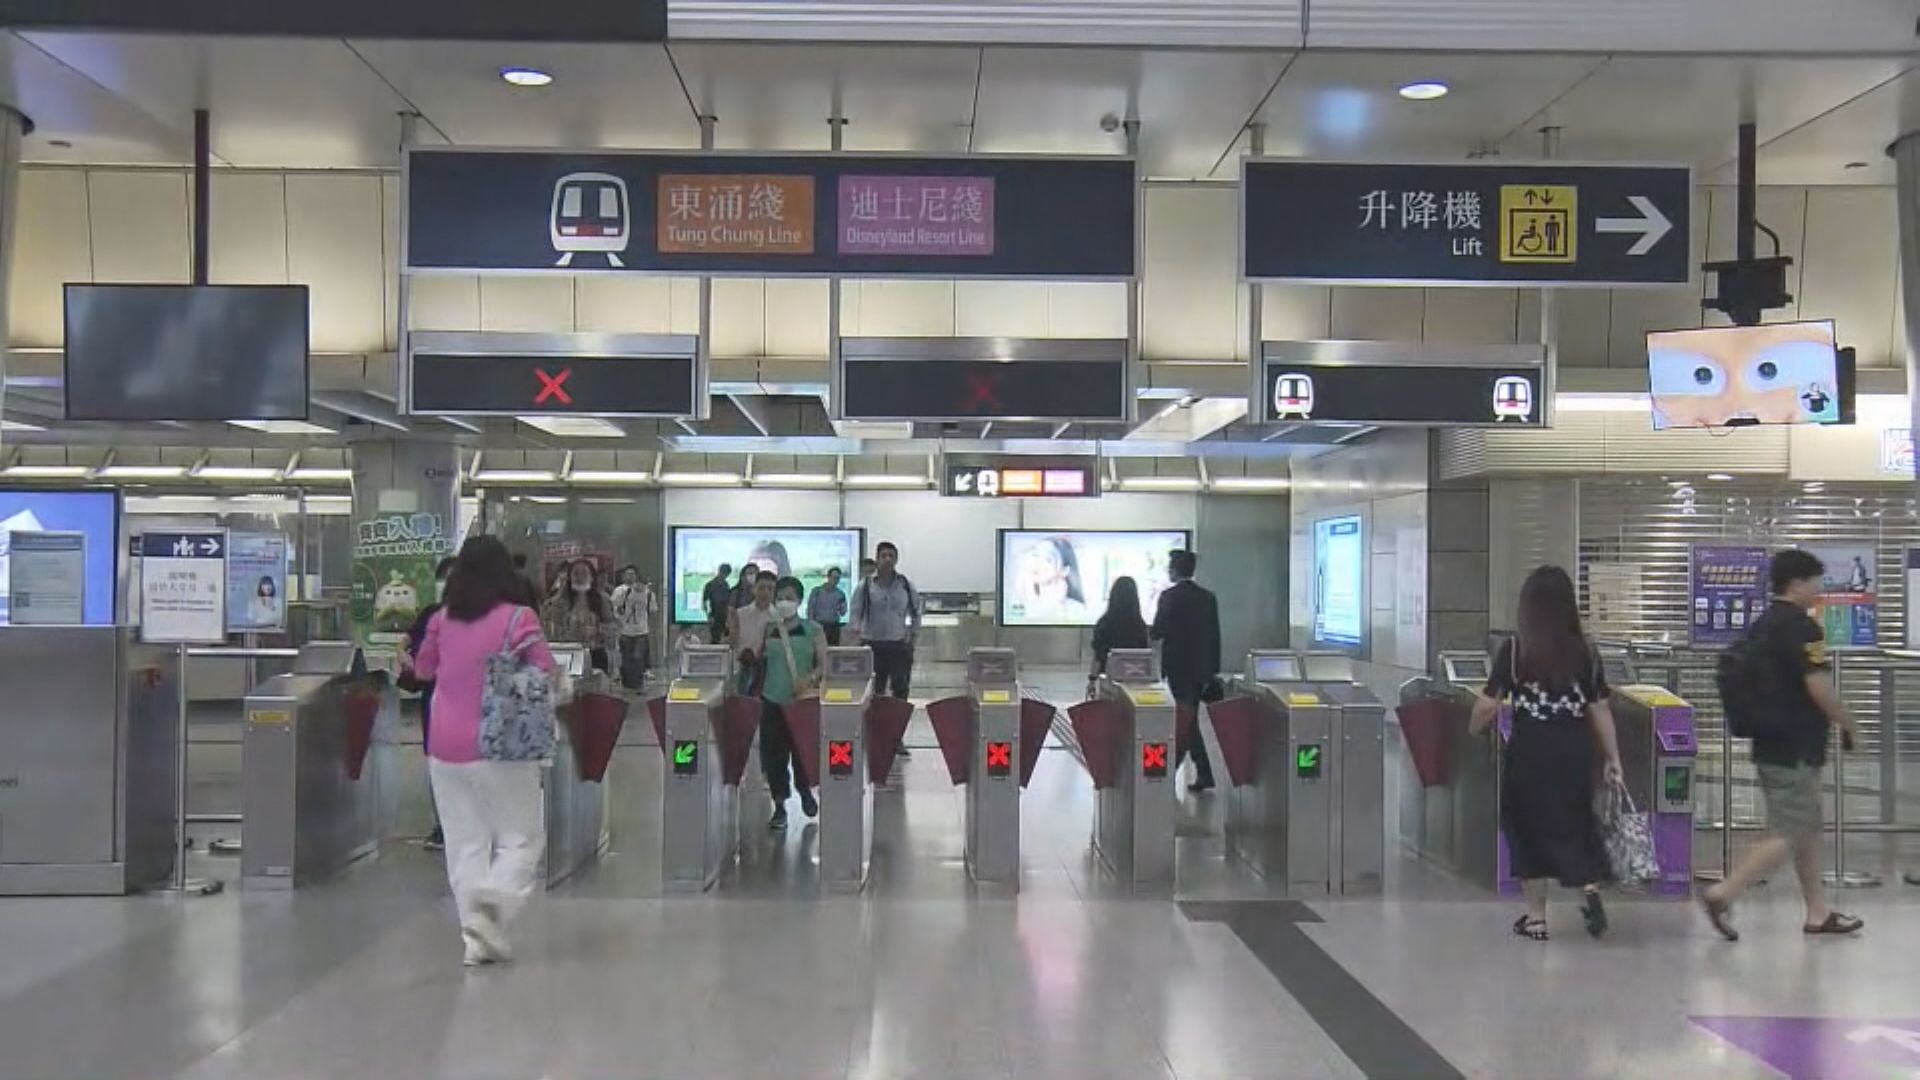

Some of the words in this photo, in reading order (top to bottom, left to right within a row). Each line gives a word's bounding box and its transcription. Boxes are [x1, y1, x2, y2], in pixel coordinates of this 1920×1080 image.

[669, 183, 785, 221] 東涌綫
[851, 185, 983, 222] 迪士尼綫
[1359, 190, 1481, 229] 升降機
[668, 226, 706, 247] Tung
[711, 224, 764, 247] Chung
[768, 225, 801, 244] Line
[847, 228, 914, 248] Disneyland
[917, 229, 955, 245] Resort
[959, 229, 985, 245] Line
[1453, 238, 1482, 256] Lift
